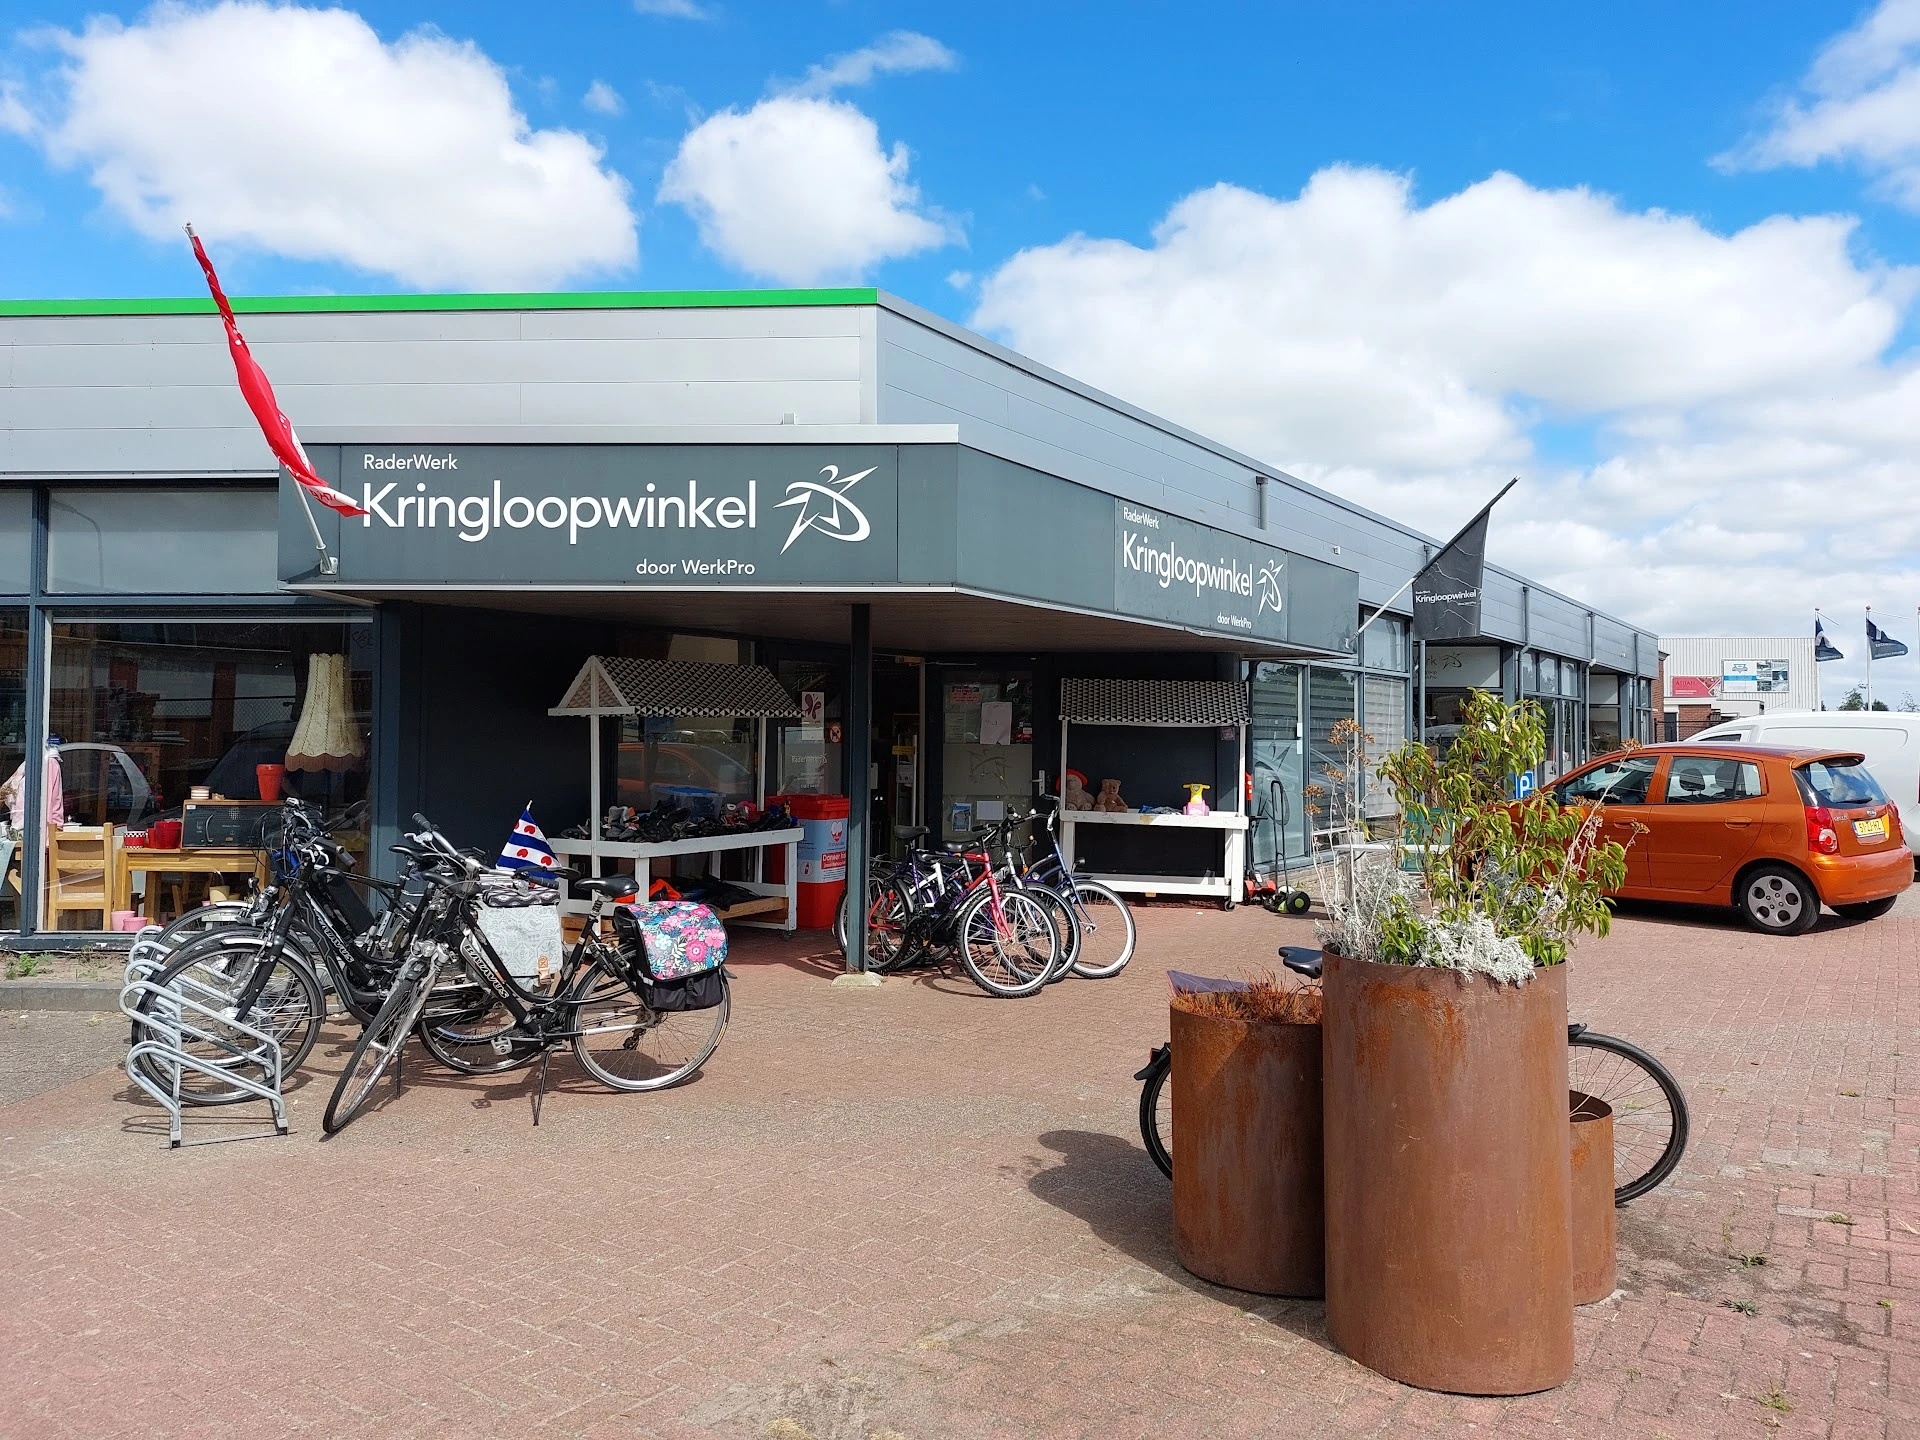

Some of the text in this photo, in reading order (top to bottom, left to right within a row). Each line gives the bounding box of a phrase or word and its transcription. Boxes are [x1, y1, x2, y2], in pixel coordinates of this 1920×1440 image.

[362, 453, 458, 470] RaderWerk
[362, 479, 757, 545] Kringloopwinkel
[1123, 506, 1160, 529] RaderWerk
[635, 558, 756, 575] door WerkPro
[1123, 530, 1253, 598] Kringloopwinkel
[1415, 588, 1477, 604] Kringloopwinkel
[1217, 611, 1252, 630] door WerkPro
[1520, 775, 1530, 798] P
